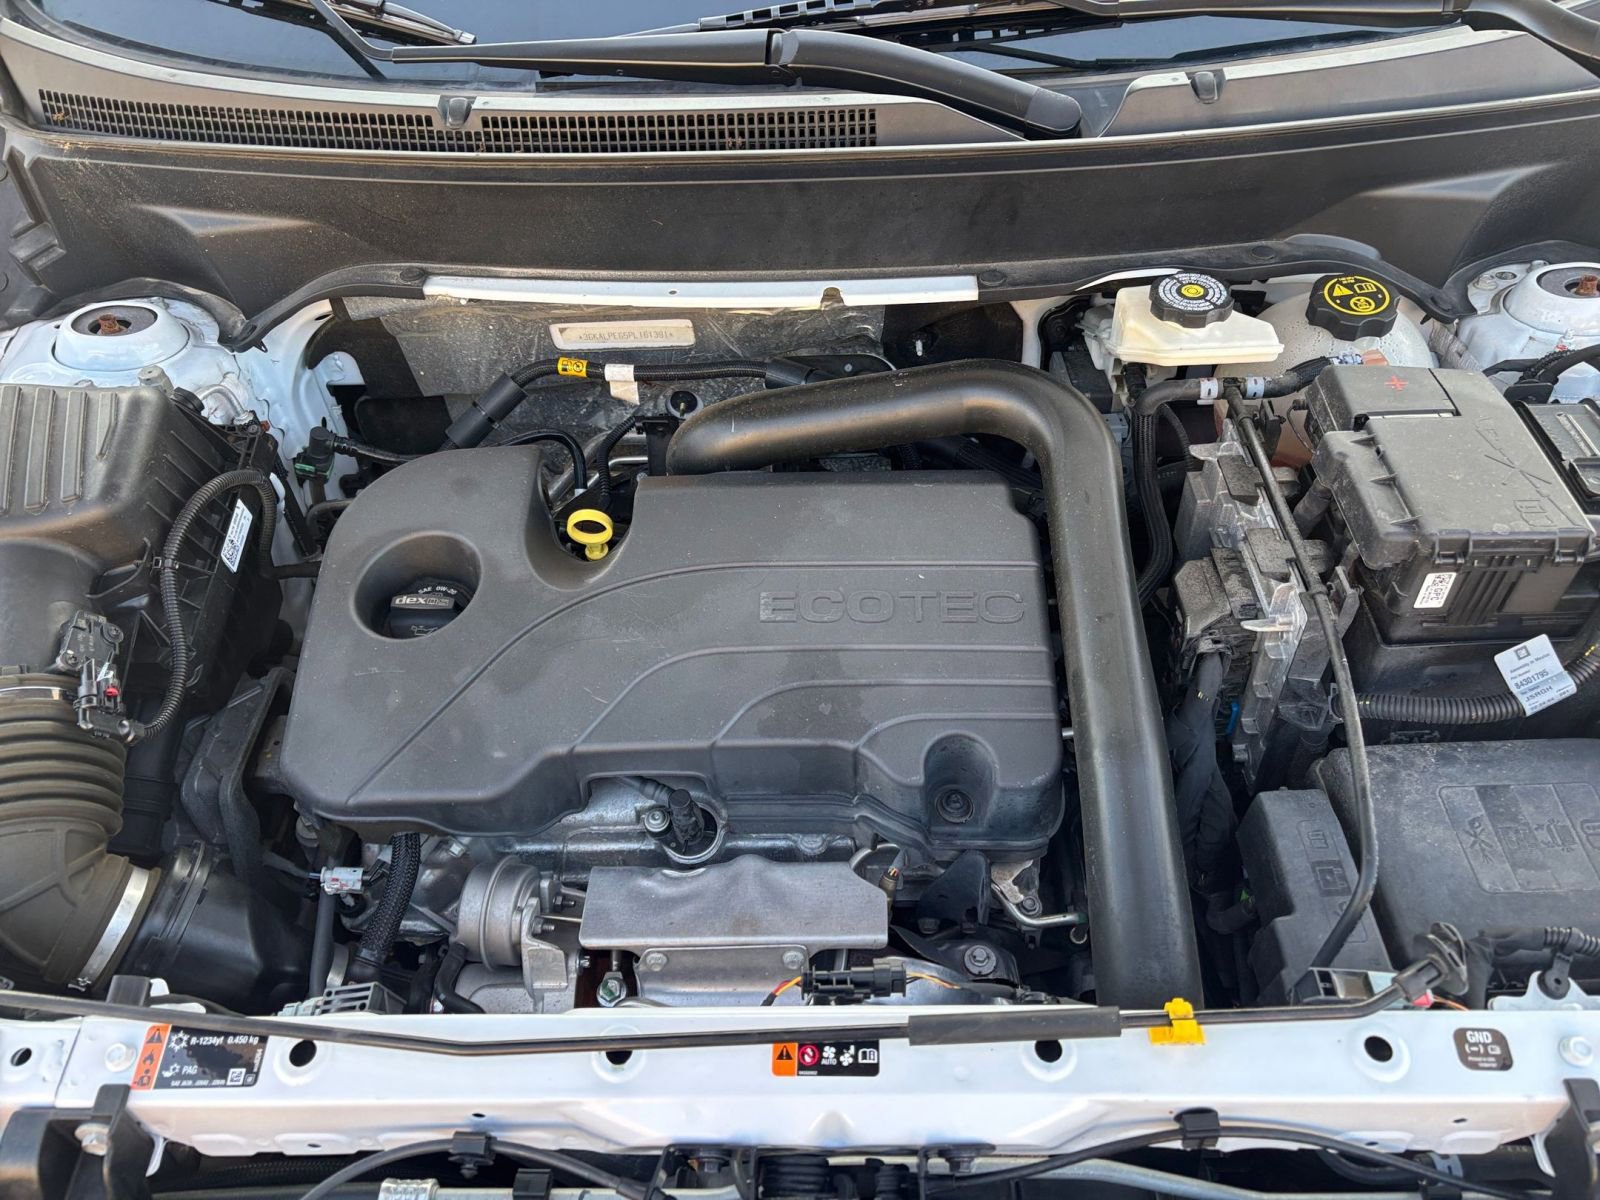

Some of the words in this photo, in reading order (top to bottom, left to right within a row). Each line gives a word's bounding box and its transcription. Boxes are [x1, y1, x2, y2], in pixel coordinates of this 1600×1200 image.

[418, 586, 433, 594] SAE
[759, 590, 1025, 624] ECOTEC
[1514, 669, 1550, 690] 84301795
[190, 1035, 225, 1047] R-1234yf
[227, 1035, 248, 1045] 0.450
[249, 1035, 260, 1046] kg
[1466, 1030, 1492, 1043] GND
[181, 1065, 199, 1075] PAG
